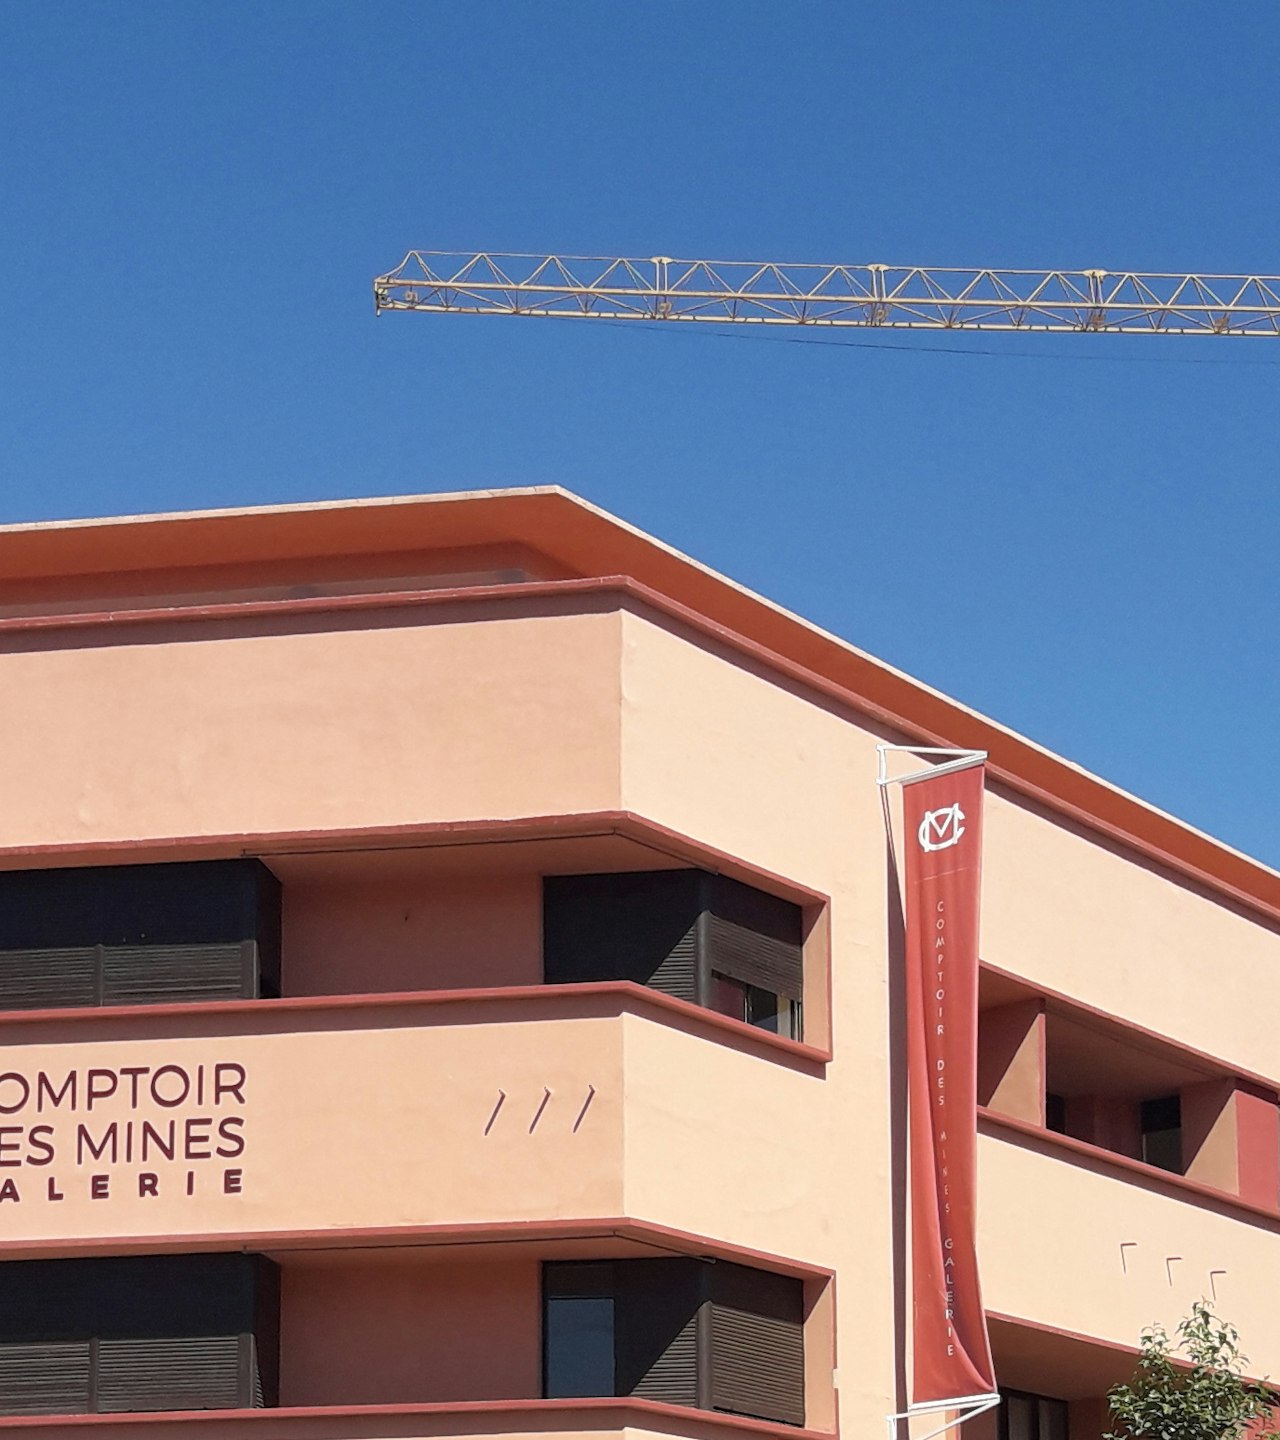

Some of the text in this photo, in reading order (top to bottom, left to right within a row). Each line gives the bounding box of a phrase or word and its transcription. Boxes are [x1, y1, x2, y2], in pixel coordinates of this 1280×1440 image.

[75, 1115, 248, 1165] MINES
[935, 900, 955, 1357] COMPTOIR DES MINES GALERIE
